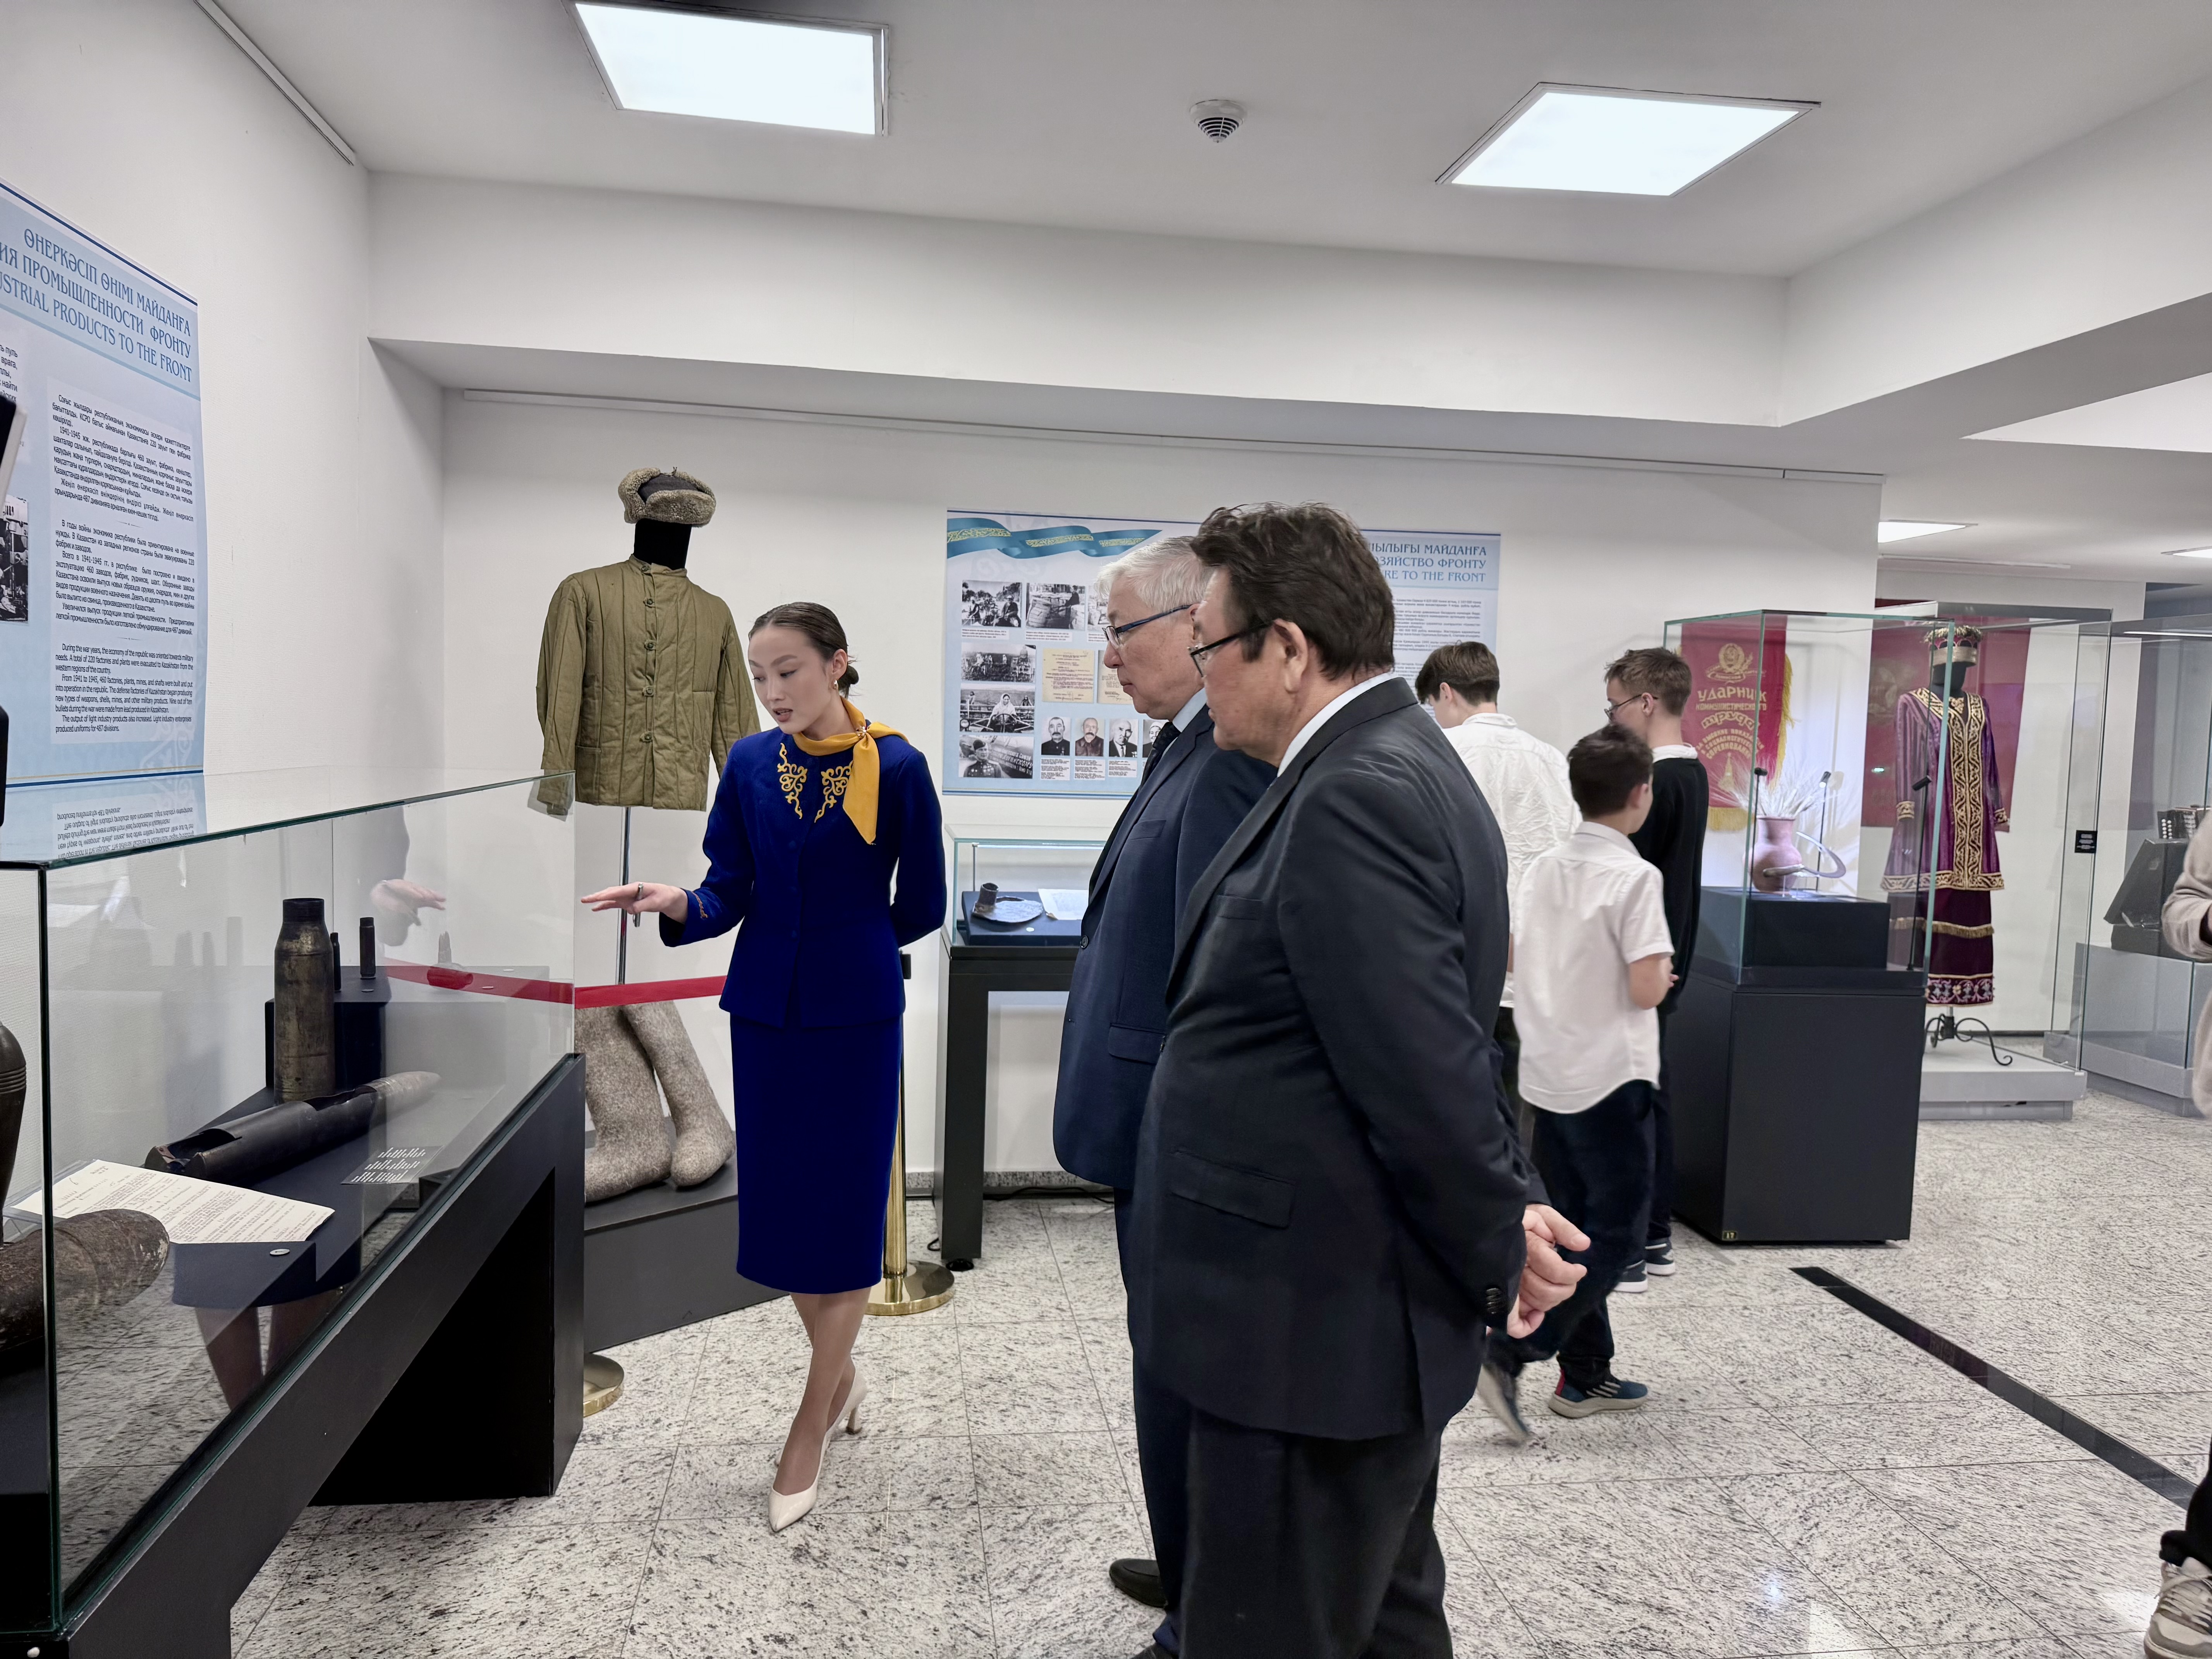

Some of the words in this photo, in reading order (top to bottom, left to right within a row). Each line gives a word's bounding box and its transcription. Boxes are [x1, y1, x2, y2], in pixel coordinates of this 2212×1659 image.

[24, 228, 98, 285] ӨНЕРКӘСІП
[101, 273, 134, 304] ӨНІМІ
[136, 292, 191, 337] МАЙДАНҒА
[22, 256, 144, 335] ПРОМЫШЛЕННОСТИ
[150, 326, 191, 359] ФРОНТУ
[53, 299, 116, 345] PRODUCTS
[118, 332, 133, 354] TO
[136, 342, 157, 366] THE
[160, 355, 192, 383] FRONT
[1424, 544, 1487, 556] МАЙДАНҒА
[1438, 558, 1486, 569] ФРОНТУ
[1402, 570, 1418, 580] TO
[1422, 571, 1444, 580] THE
[1448, 572, 1486, 582] FRONT
